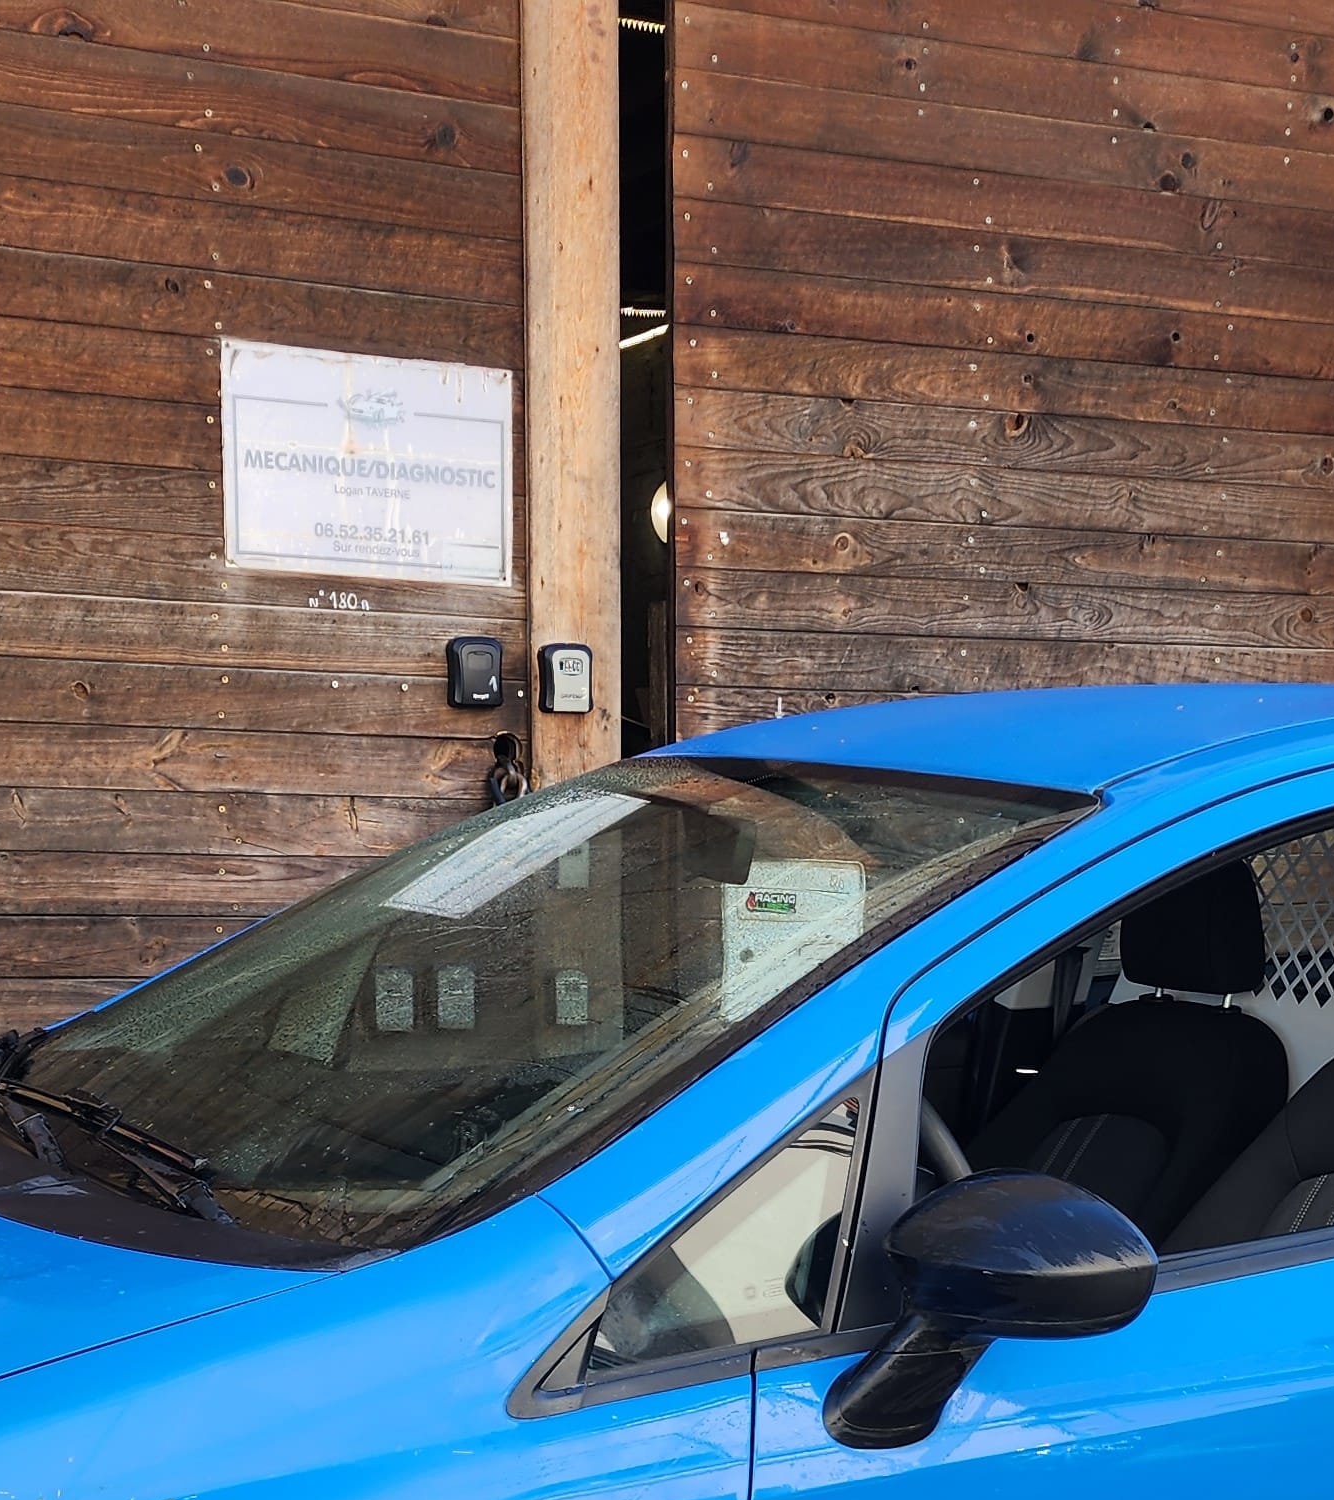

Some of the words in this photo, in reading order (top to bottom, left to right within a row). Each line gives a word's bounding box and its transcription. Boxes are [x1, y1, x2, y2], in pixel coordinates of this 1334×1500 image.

[244, 448, 496, 489] MECANIQUE/DIAGNOSTIC
[334, 483, 363, 497] Logan
[365, 486, 411, 500] TAVERNE
[314, 522, 430, 545] 06.52.35.21.61
[333, 540, 352, 553] Sur
[354, 545, 420, 558] rendez-vous
[329, 591, 358, 610] 180
[754, 893, 796, 905] RACING
